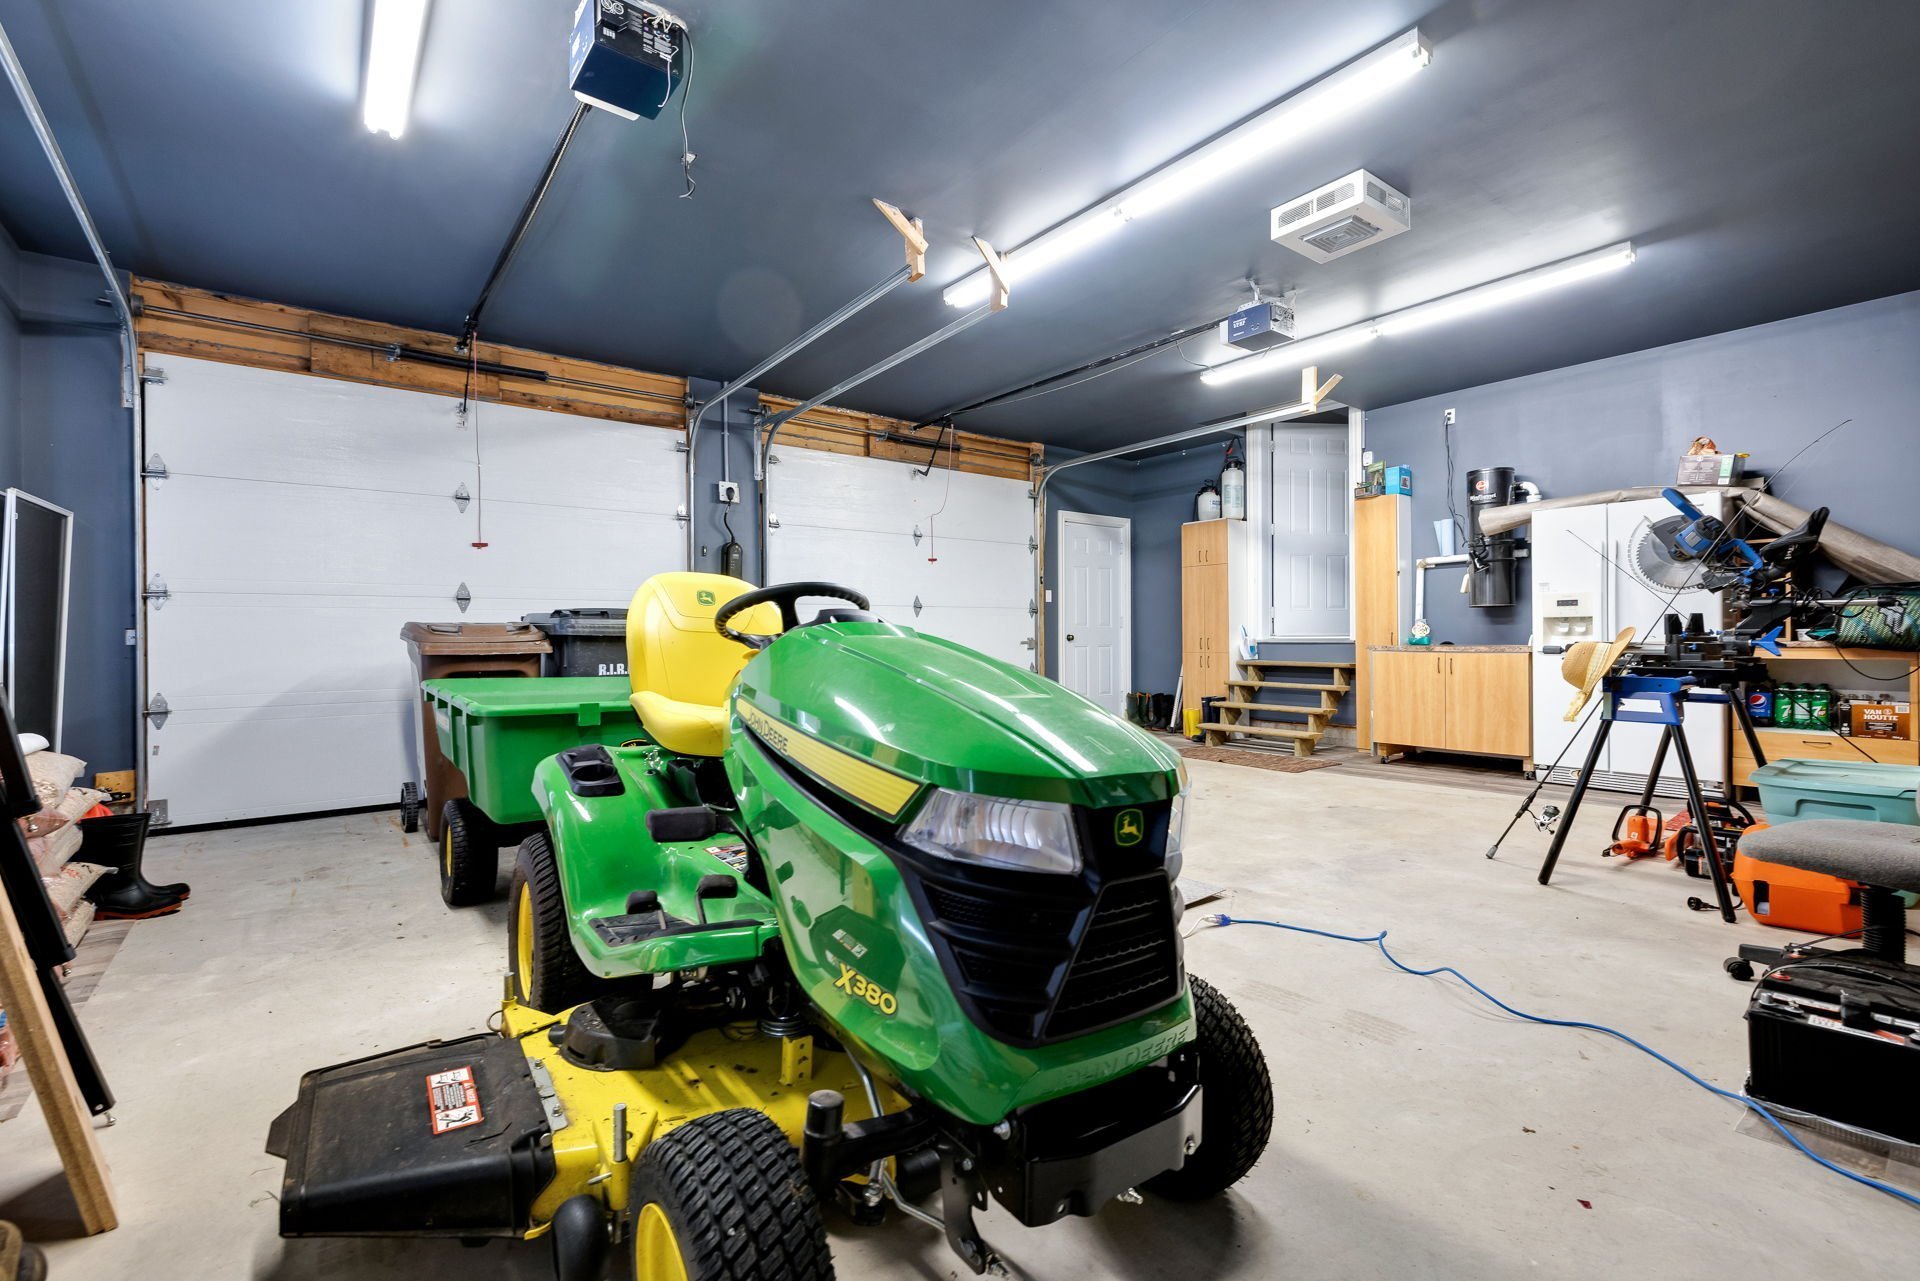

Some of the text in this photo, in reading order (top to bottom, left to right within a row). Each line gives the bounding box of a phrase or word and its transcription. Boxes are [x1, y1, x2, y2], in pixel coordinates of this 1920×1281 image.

[763, 719, 789, 753] DEERE
[833, 962, 898, 1015] X380
[1126, 1025, 1189, 1068] DEERE
